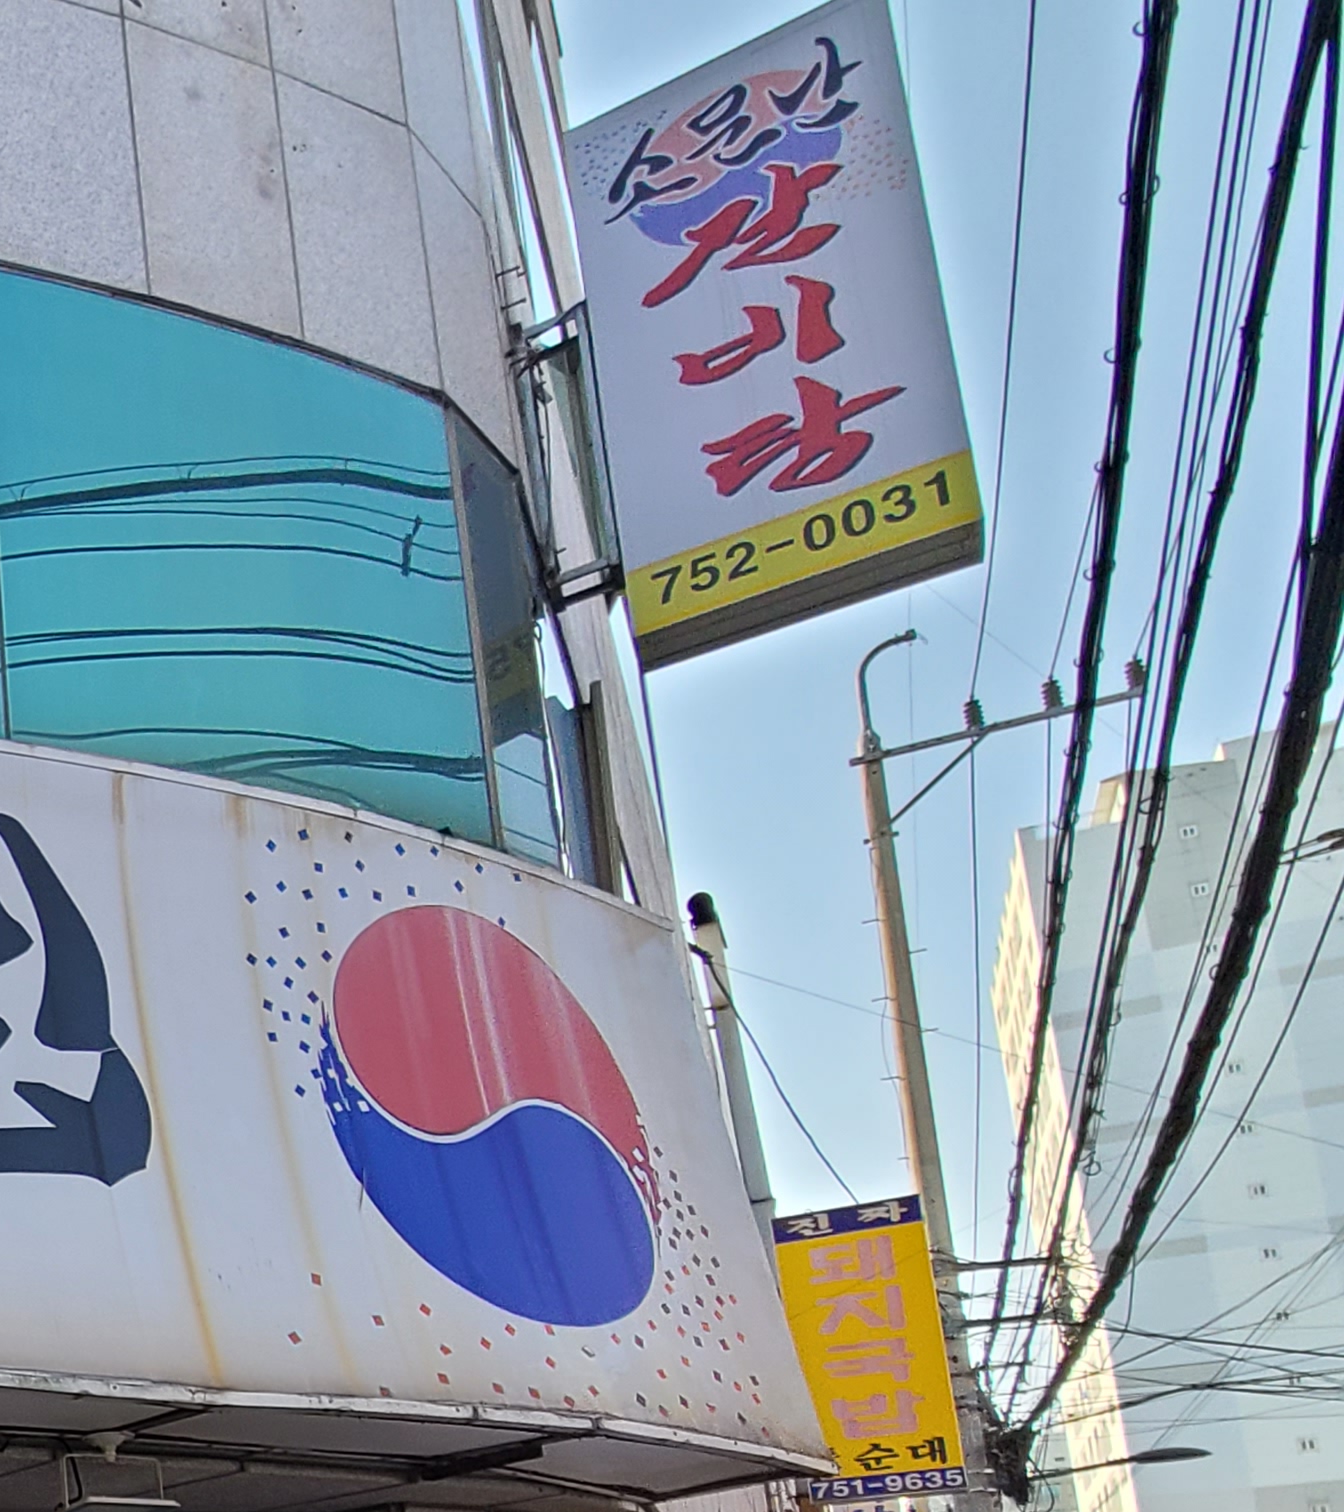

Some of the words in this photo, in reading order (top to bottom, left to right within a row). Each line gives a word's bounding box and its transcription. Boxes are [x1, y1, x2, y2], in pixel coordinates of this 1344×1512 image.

[605, 37, 863, 226] 소문난
[641, 162, 907, 498] 갈비탕
[650, 469, 953, 606] 752-0031
[786, 1201, 909, 1237] 진짜
[808, 1234, 926, 1441] 돼지국밥
[812, 1469, 963, 1500] 751-9635
[828, 1436, 948, 1471] 순대
